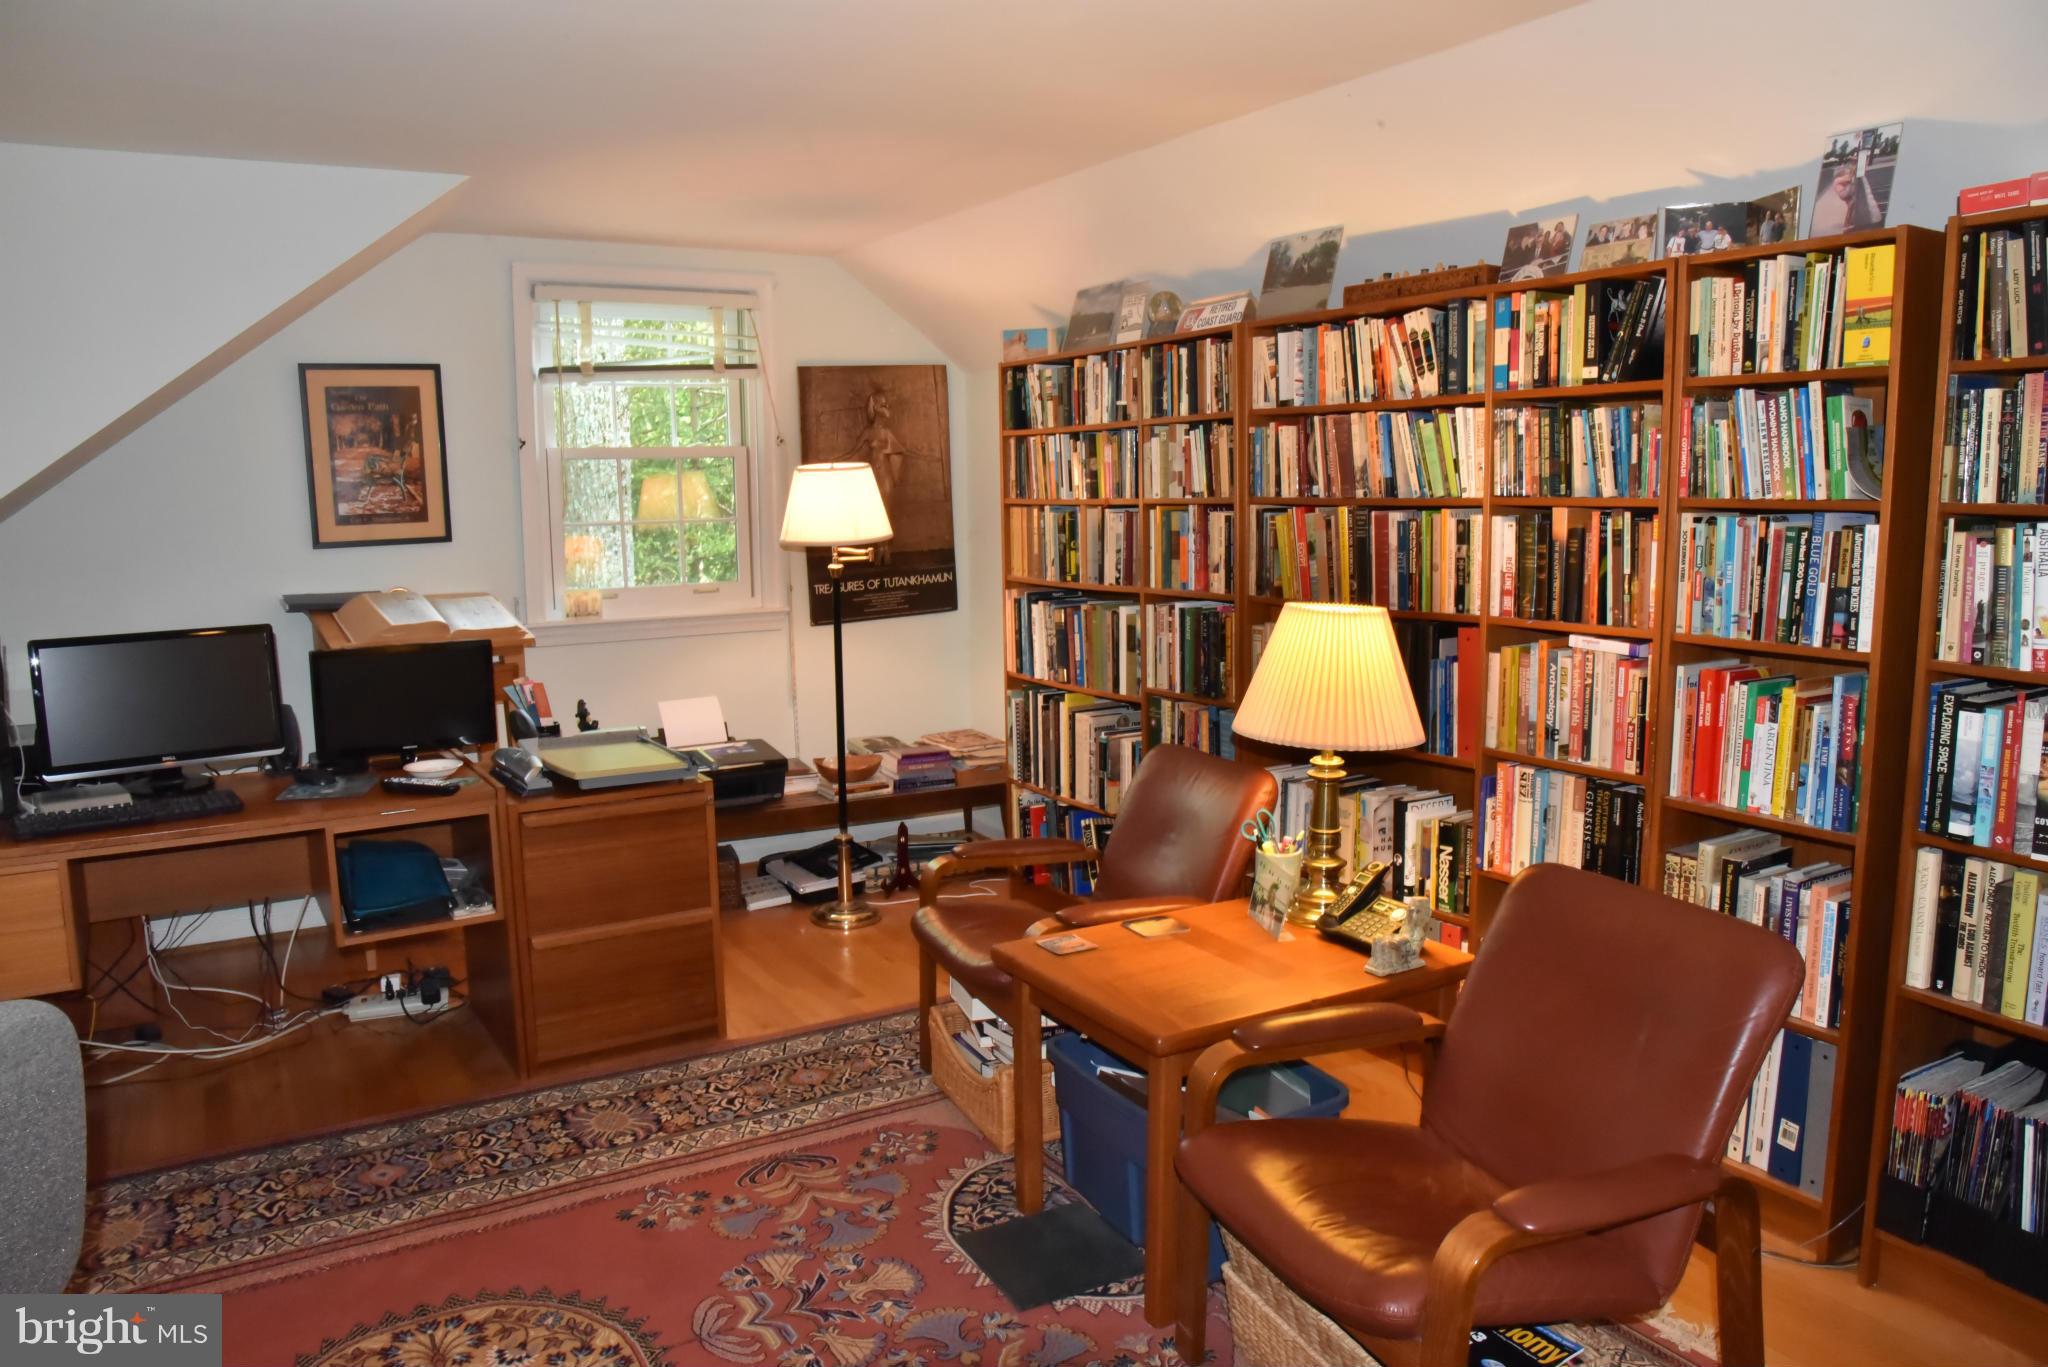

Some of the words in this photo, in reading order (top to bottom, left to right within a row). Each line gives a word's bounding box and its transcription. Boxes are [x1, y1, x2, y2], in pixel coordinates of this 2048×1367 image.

[1996, 257, 2004, 268] and
[2012, 268, 2020, 285] LADY
[1209, 300, 1237, 316] RETIRED
[1732, 289, 1742, 318] Britain
[1196, 316, 1218, 329] COAST
[1218, 312, 1244, 327] GUARD
[1732, 320, 1741, 330] by
[1768, 399, 1779, 436] WYOMING
[1778, 396, 1788, 422] IDAHO
[1680, 437, 1688, 478] COTSWOLDS
[1762, 442, 1770, 476] MEXICO
[1771, 437, 1780, 481] HANDBOOK
[1781, 423, 1790, 469] HANDBOOK
[2037, 442, 2048, 468] STARS
[1800, 531, 1808, 544] The
[1810, 535, 1821, 565] BLUE
[1851, 532, 1863, 568] Adventuring
[1298, 542, 1306, 568] EGYPT
[1783, 542, 1794, 570] MONTANA
[1798, 545, 1806, 561] Next
[1840, 548, 1849, 576] Rockies
[2038, 528, 2048, 578] AUSTRALIA
[866, 578, 881, 590] OF
[883, 571, 953, 587] TUTANKHAMUN
[1725, 561, 1733, 584] INDIA
[1796, 562, 1805, 579] 200
[1806, 567, 1819, 597] GOLD
[1852, 575, 1861, 585] the
[1966, 566, 1974, 584] Fads
[1978, 561, 1987, 592] prague
[1997, 567, 2007, 594] BECOMING
[1794, 579, 1804, 600] Years
[1850, 586, 1861, 612] ROCKIES
[1963, 590, 1972, 622] Fallacies
[1584, 654, 1593, 685] EBLA
[1546, 663, 1557, 726] Archaeology
[1685, 714, 1693, 742] FRENCH
[1844, 703, 1854, 752] DESTINY
[1940, 694, 1955, 745] EXPLORING
[1762, 724, 1776, 786] ARGENTINA
[1936, 745, 1950, 774] SPACE
[2002, 749, 2011, 778] BREAKING
[1496, 779, 1504, 812] VISUELLE
[2001, 779, 2009, 790] THE
[2000, 791, 2008, 807] MAYA
[1584, 791, 1594, 842] GENESIS
[1636, 800, 1644, 828] Abydos
[1998, 808, 2007, 823] CODE
[1438, 845, 1453, 903] Nasser
[1726, 864, 1734, 873] The
[1988, 866, 1997, 889] ALLEN
[1967, 872, 1978, 893] ALLEN
[1784, 896, 1793, 918] LIVES
[1964, 894, 1976, 918] DRURY
[1985, 888, 1995, 912] DRURY
[1784, 918, 1792, 929] OF
[1959, 920, 1967, 932] THE
[1966, 928, 1975, 941] GOD
[1982, 912, 1993, 941] RETURN
[2010, 912, 2021, 937] Twelfth
[1957, 932, 1966, 950] GODS
[1980, 942, 1990, 952] TO
[2017, 943, 2025, 956] The
[1963, 942, 1974, 968] AGAINST
[2006, 938, 2017, 984] Transforming
[2035, 952, 2045, 978] howard
[2035, 979, 2044, 994] fast
